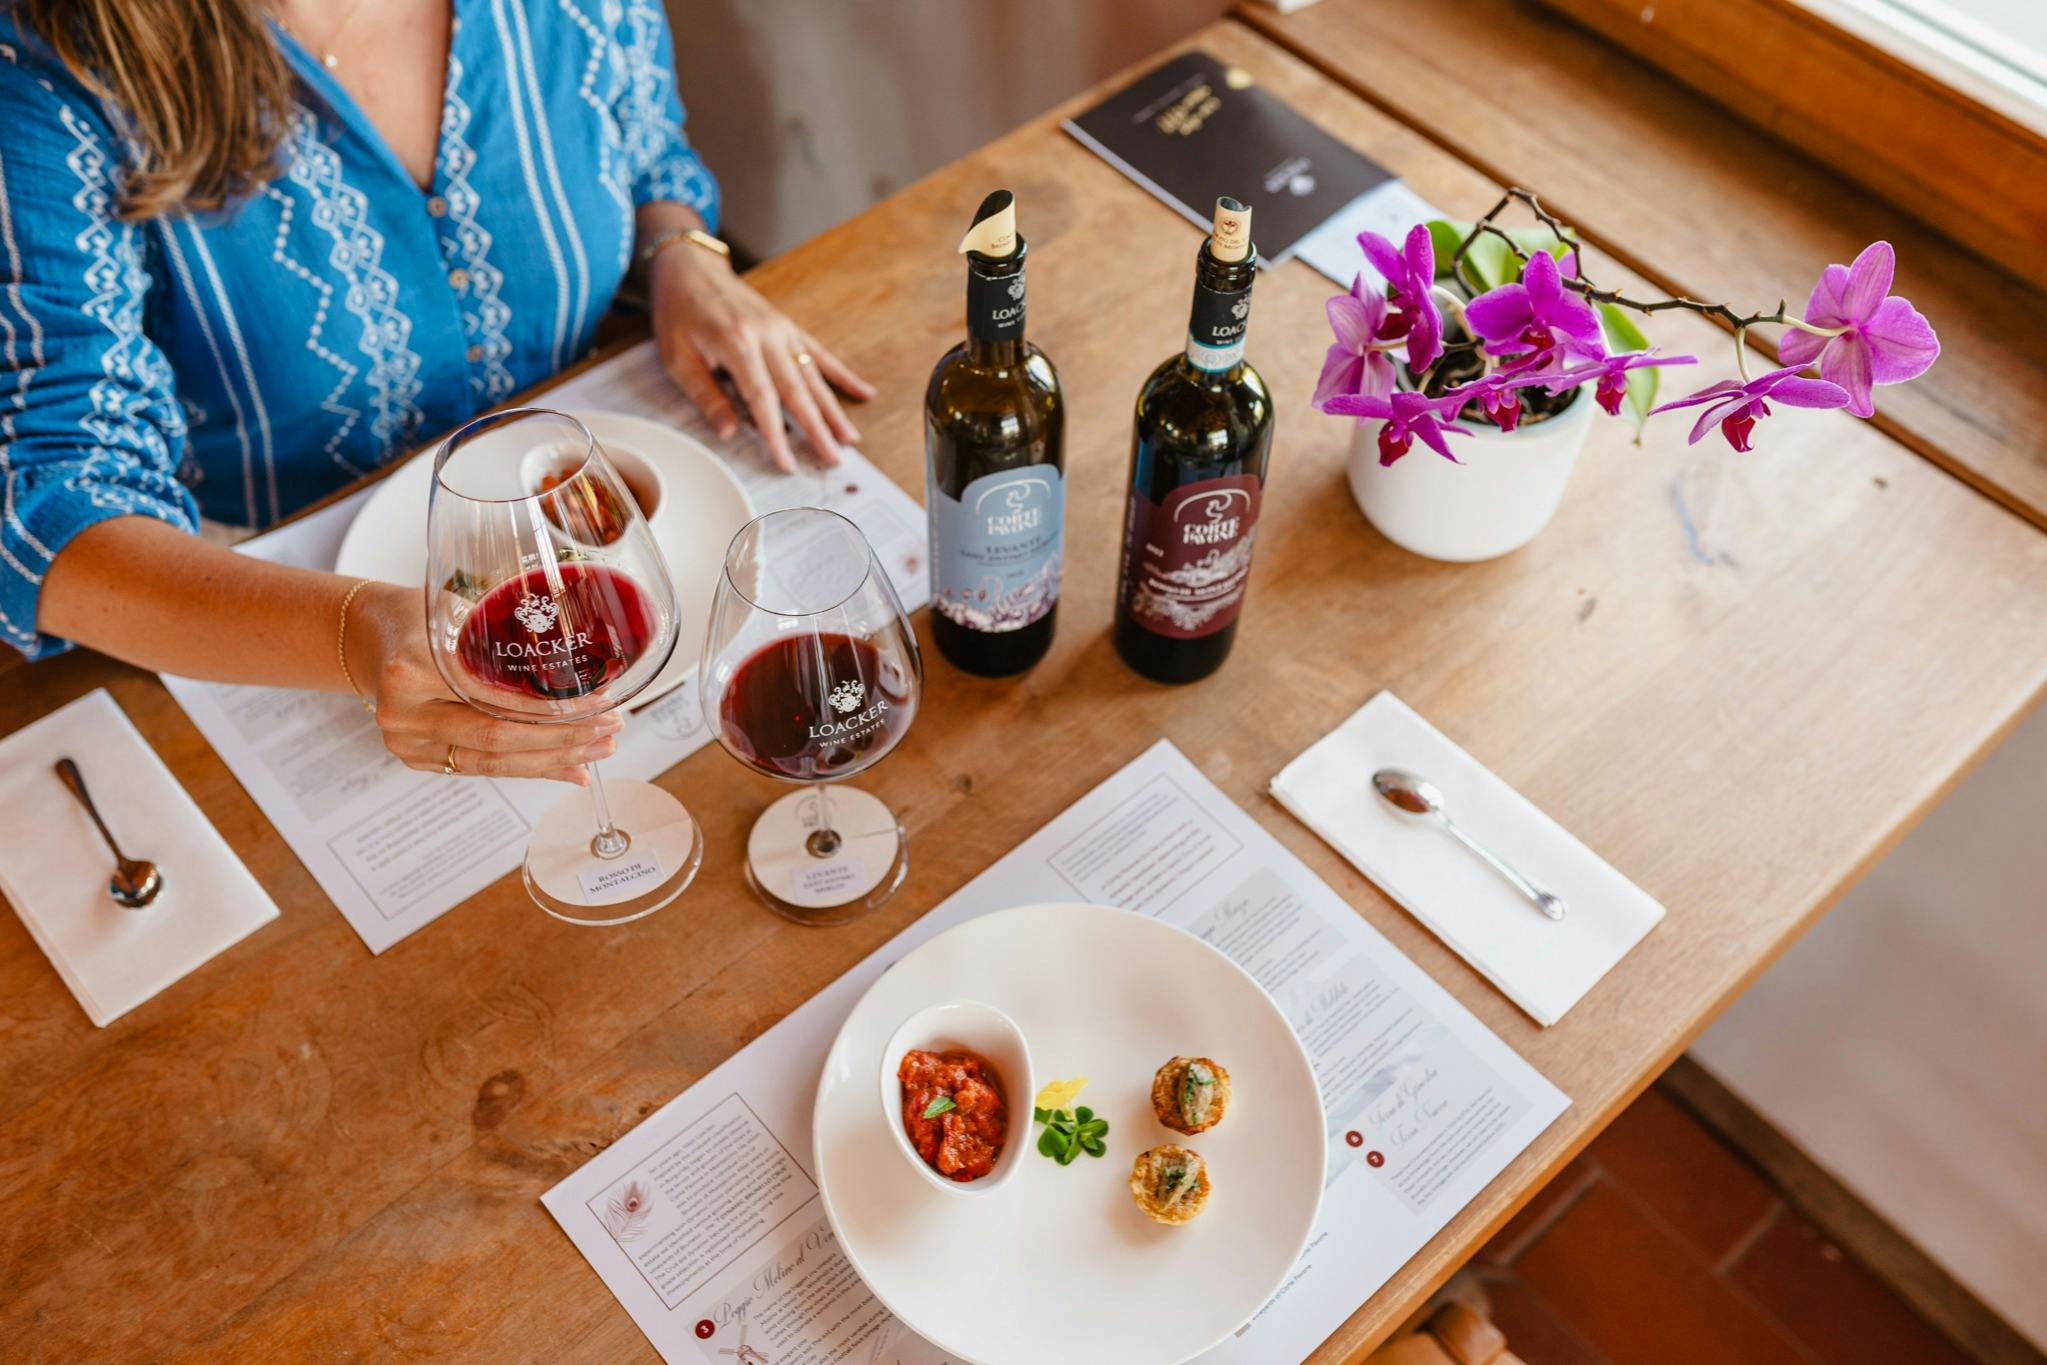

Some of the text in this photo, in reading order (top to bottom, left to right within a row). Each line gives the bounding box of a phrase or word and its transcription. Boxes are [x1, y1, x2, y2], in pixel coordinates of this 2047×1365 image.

[495, 632, 593, 658] LOACKER
[508, 654, 588, 672] WINE ESTATES
[808, 700, 889, 739] LOACKER
[819, 718, 886, 748] WINE ESTATES
[588, 866, 656, 895] MONTALCINO
[598, 862, 642, 883] ROSSO DI
